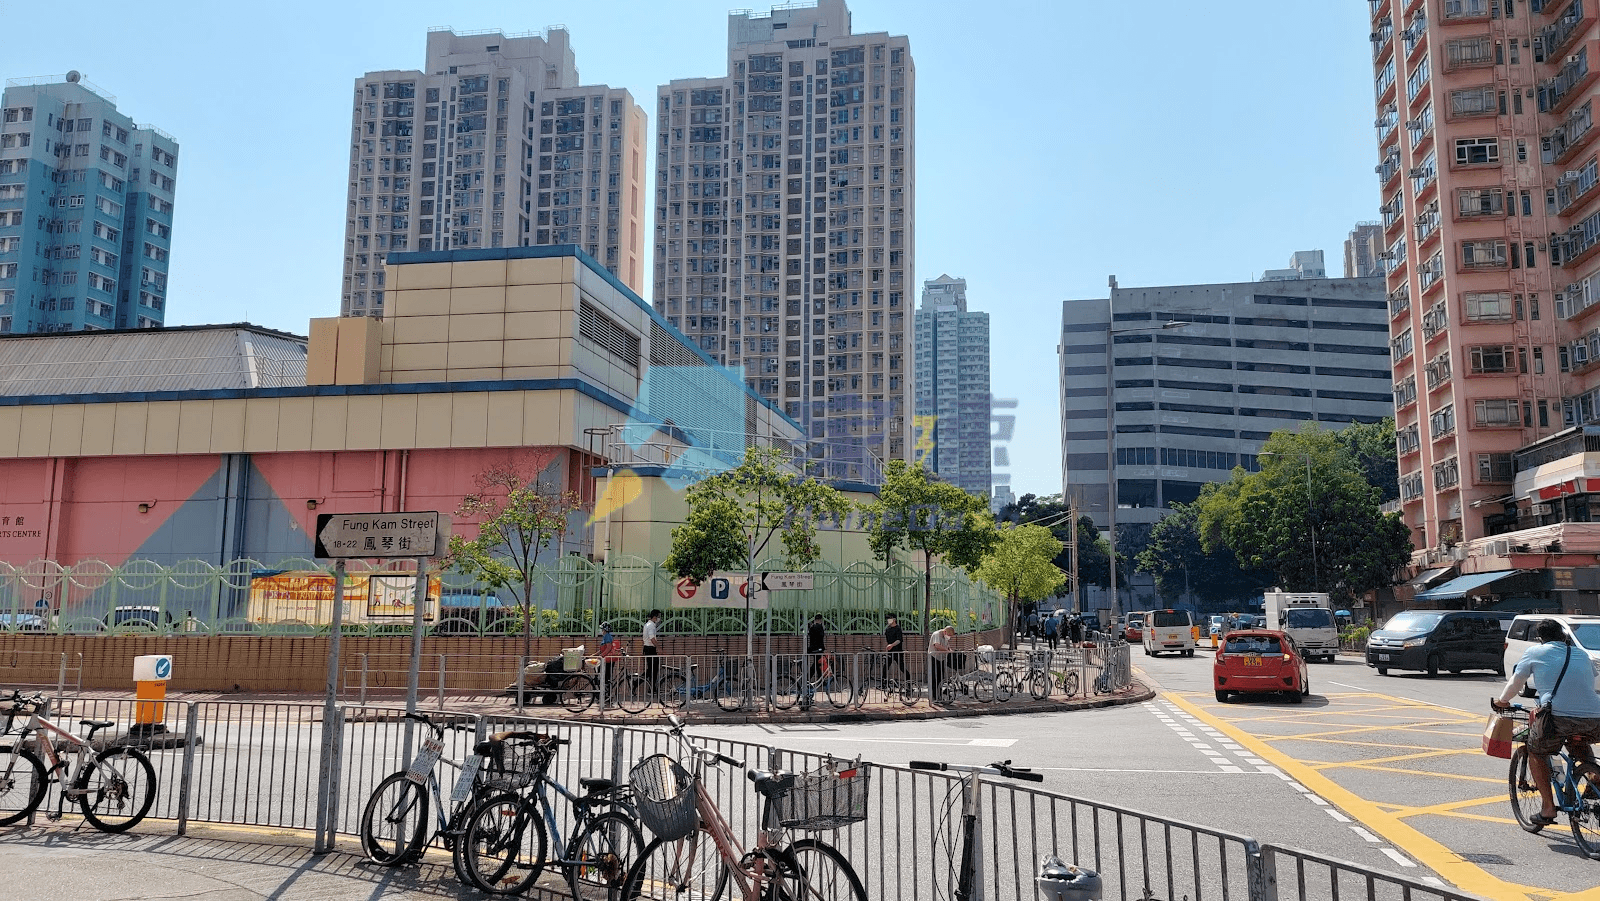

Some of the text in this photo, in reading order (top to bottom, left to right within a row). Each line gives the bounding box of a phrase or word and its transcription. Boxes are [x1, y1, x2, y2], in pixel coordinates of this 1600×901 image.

[343, 518, 434, 532] Fung Kam Street
[333, 536, 411, 551] 18-22 鳳琴街
[715, 580, 726, 597] P
